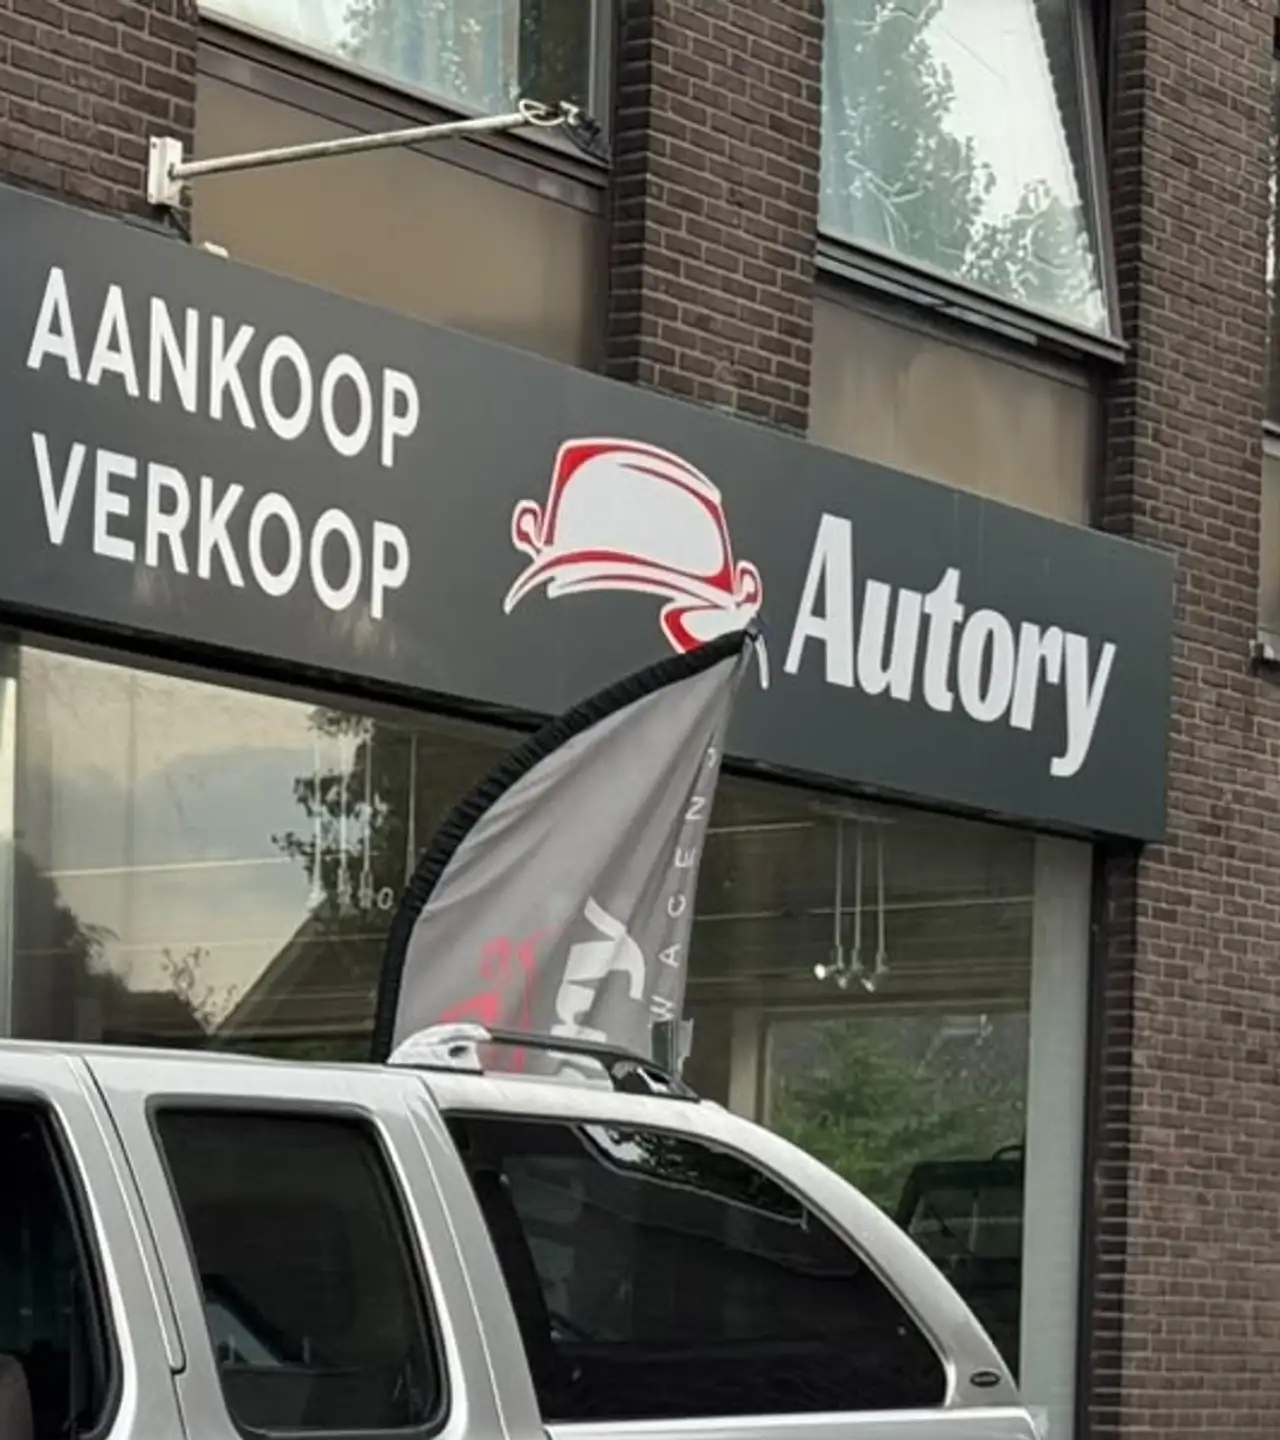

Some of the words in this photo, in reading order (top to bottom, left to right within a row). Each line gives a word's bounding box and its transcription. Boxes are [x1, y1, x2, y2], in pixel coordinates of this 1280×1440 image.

[26, 266, 420, 468] AANKOOP
[32, 431, 410, 621] VERKOOP
[784, 513, 1117, 777] Autory
